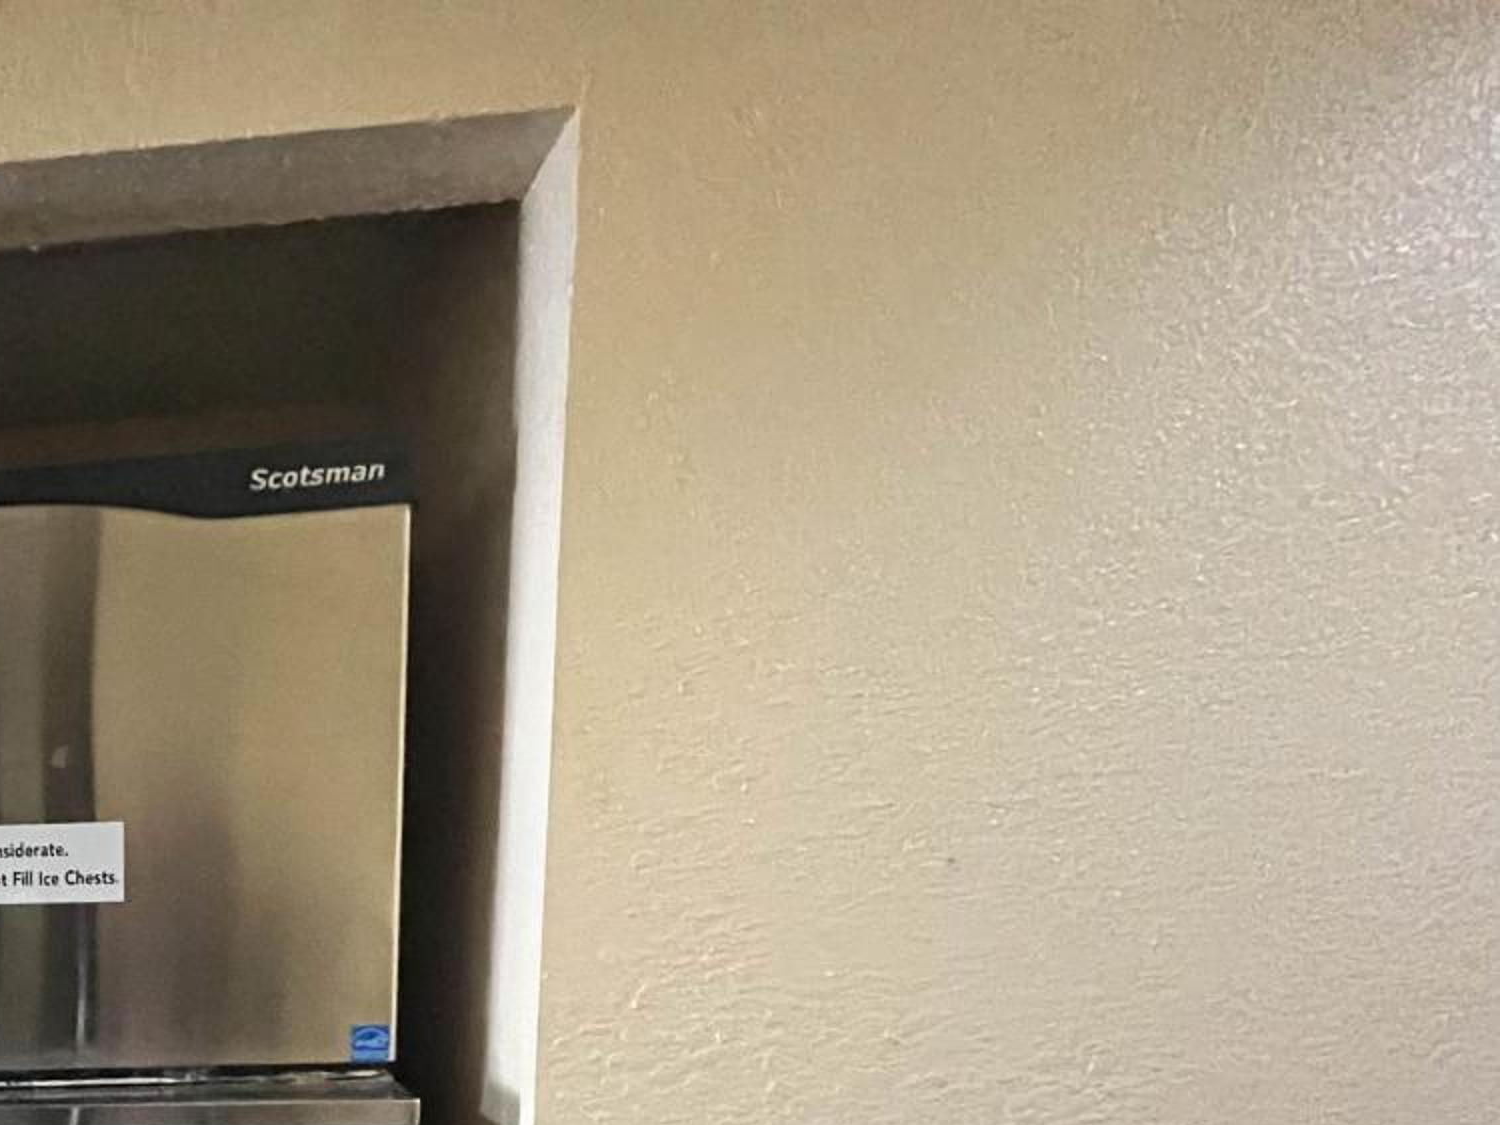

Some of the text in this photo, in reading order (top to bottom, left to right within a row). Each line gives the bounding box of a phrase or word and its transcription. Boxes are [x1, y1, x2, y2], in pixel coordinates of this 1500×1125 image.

[249, 463, 386, 491] Scotsman
[13, 871, 33, 886] Fill
[39, 870, 59, 886] Ice
